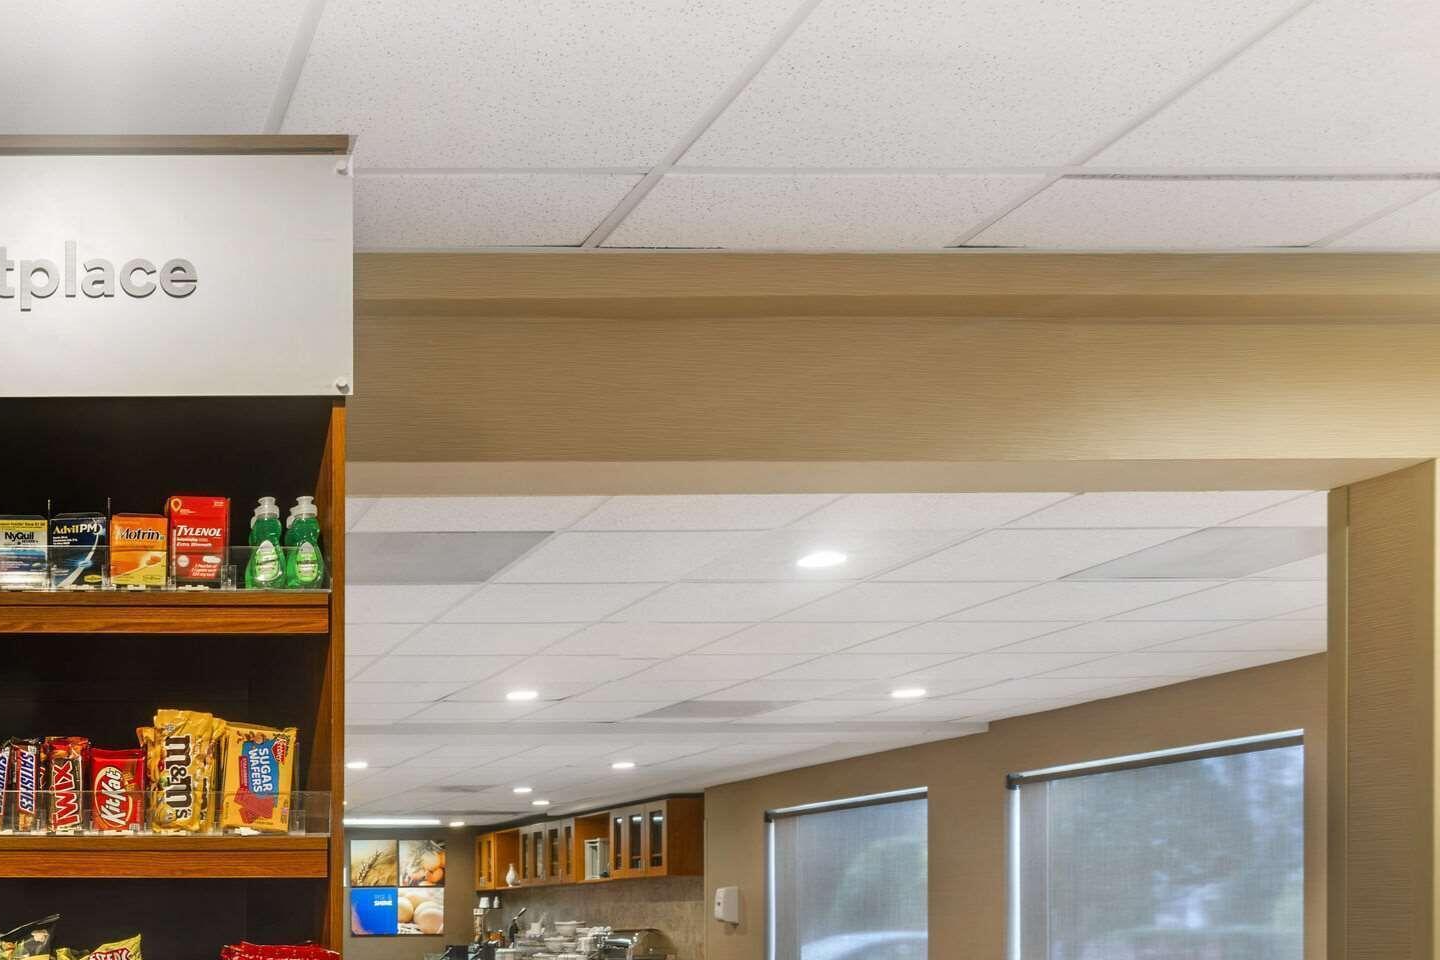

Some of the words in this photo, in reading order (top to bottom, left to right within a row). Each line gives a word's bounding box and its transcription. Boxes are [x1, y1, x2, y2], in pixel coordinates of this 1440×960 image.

[5, 532, 35, 541] NyQuil
[53, 525, 79, 535] Advil
[80, 524, 98, 533] PM
[120, 528, 160, 540] Motrin
[177, 525, 222, 537] TYLENOL
[20, 752, 35, 813] SATISFIES
[164, 735, 193, 819] m&m's
[249, 748, 262, 793] WAFERS
[259, 748, 273, 792] SUGAR
